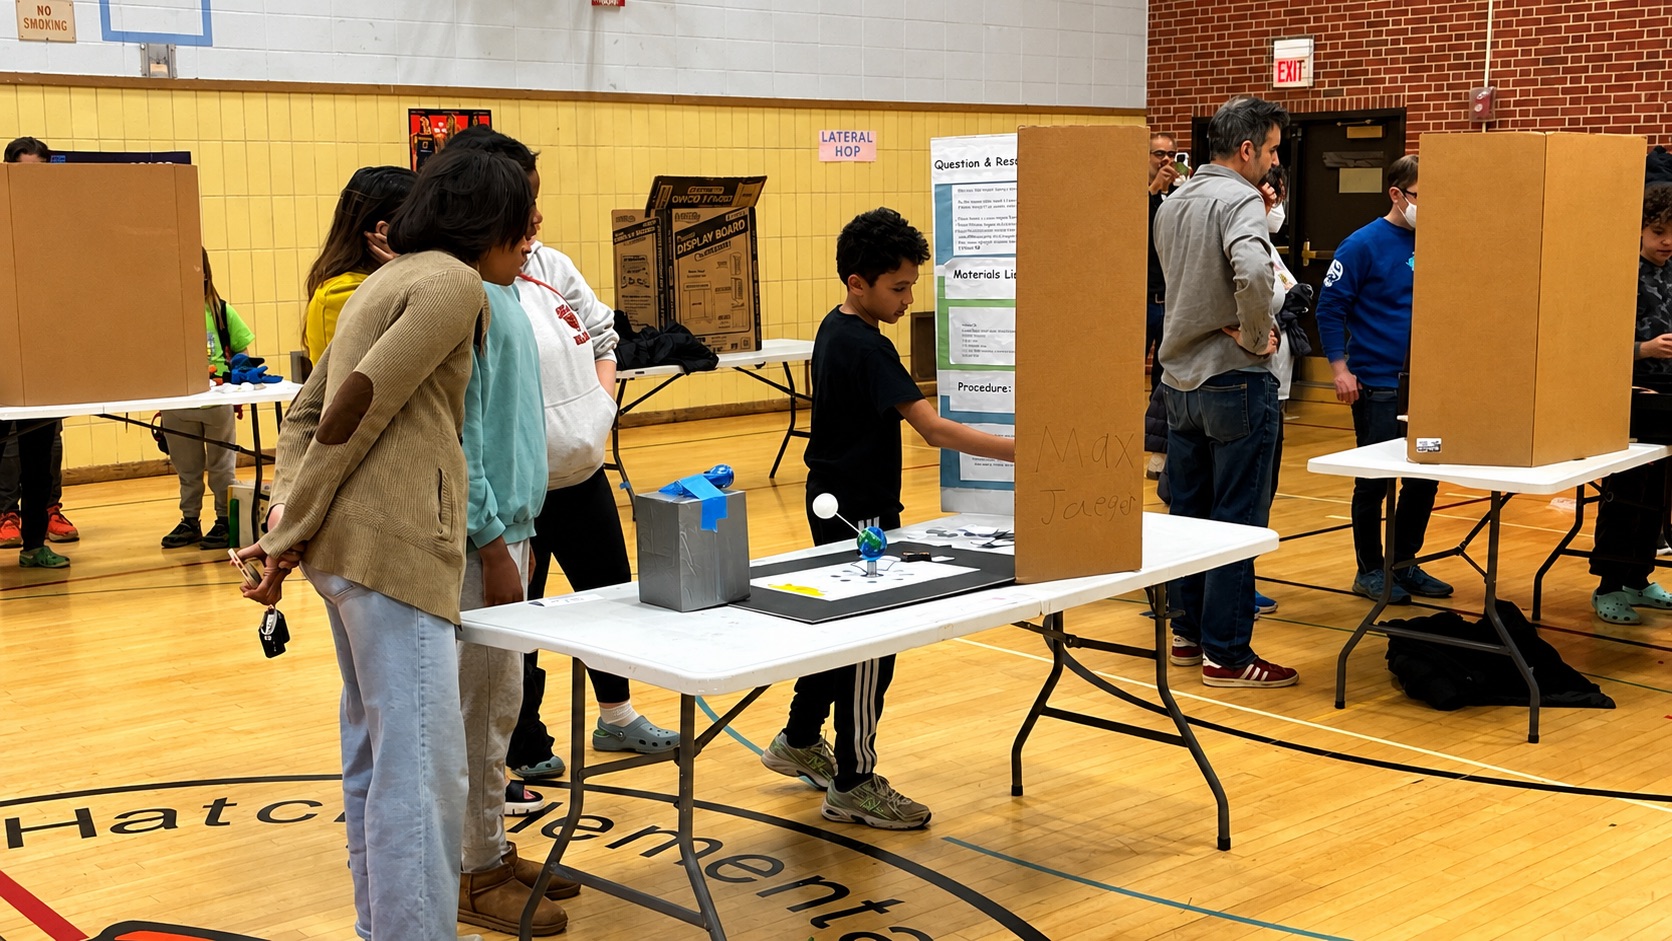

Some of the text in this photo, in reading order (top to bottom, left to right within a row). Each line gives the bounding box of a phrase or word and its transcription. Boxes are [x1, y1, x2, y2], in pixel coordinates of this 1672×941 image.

[37, 5, 52, 16] NO
[23, 17, 68, 32] SMOKING
[1277, 59, 1305, 83] EXIT
[821, 131, 873, 143] LATERAL
[835, 145, 861, 157] HOP
[934, 159, 980, 171] Question
[983, 157, 992, 168] &
[676, 230, 714, 255] DISPLAY
[953, 269, 1001, 280] Materials
[957, 381, 1012, 394] Procedure:
[1035, 424, 1135, 474] Max
[1039, 488, 1137, 526] Jaeger
[4, 796, 348, 850] Hatc
